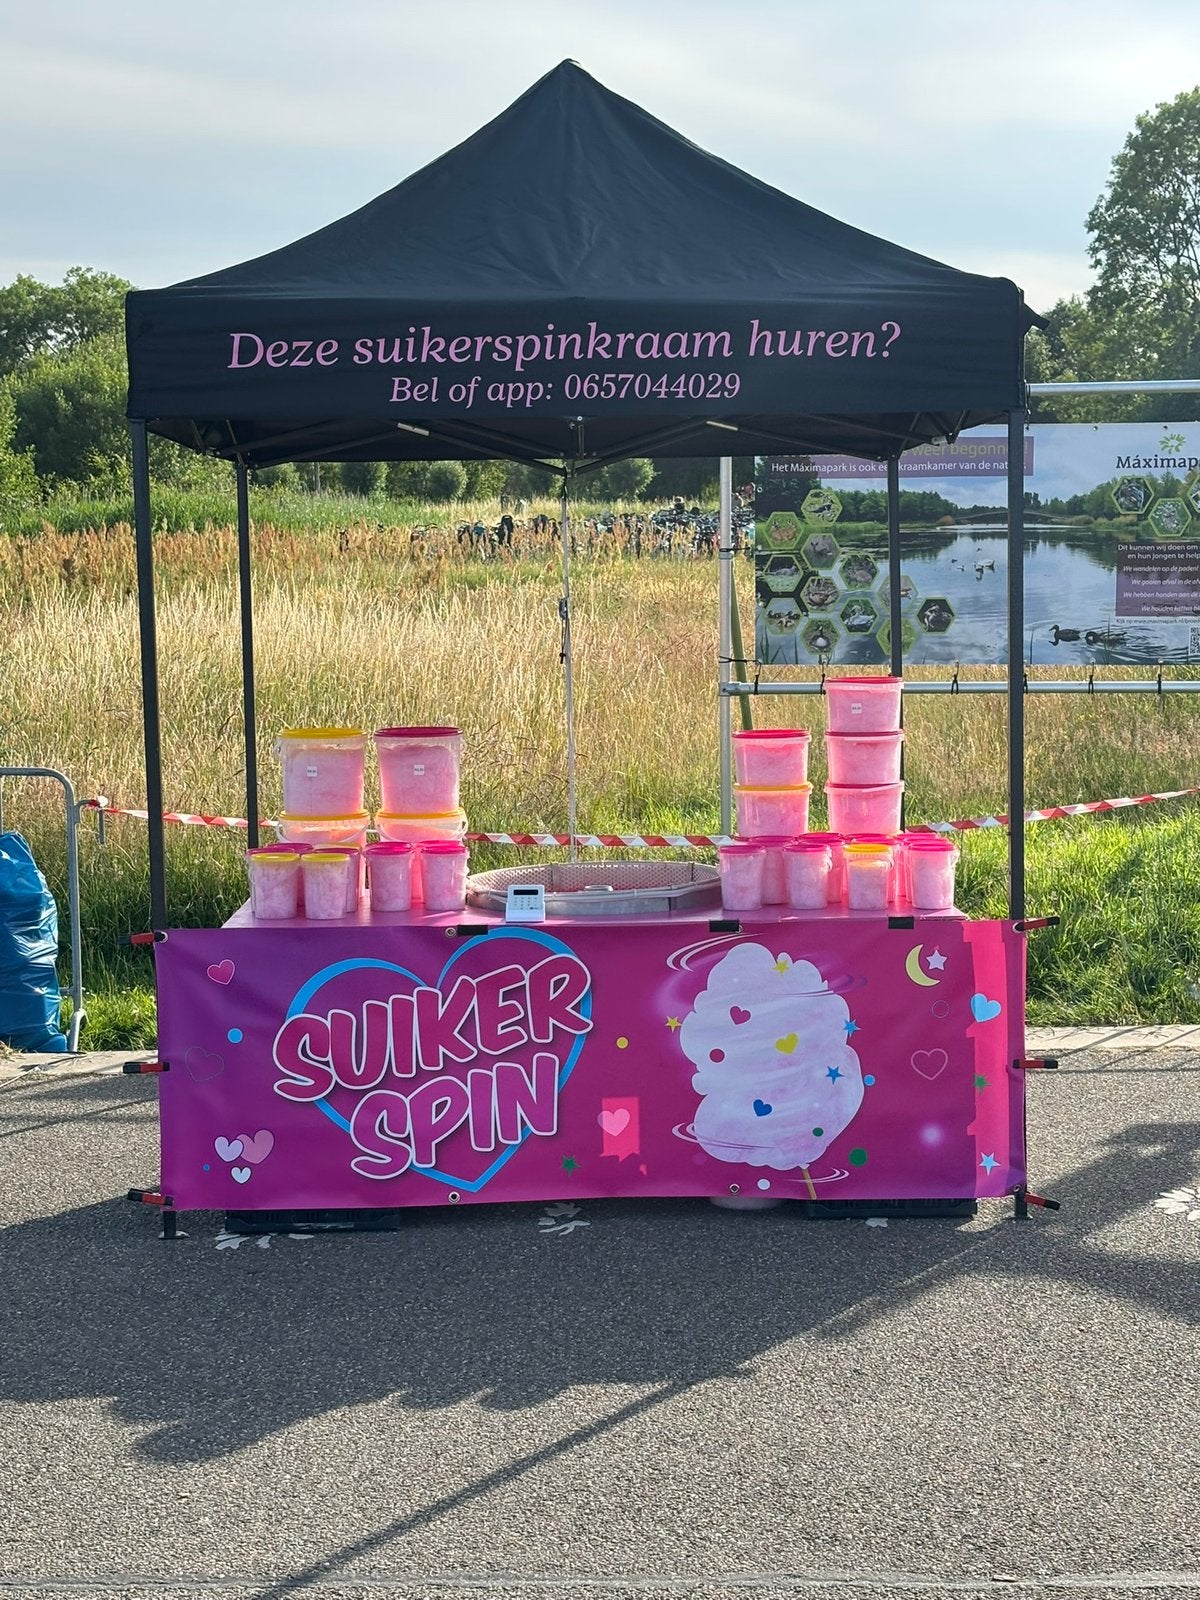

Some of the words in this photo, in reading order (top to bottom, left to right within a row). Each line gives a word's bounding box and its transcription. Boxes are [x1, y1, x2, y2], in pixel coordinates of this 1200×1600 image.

[227, 332, 339, 369] Deze
[352, 321, 735, 372] suikerspinkraam
[748, 318, 901, 358] huren?
[389, 376, 440, 402] Bel
[448, 375, 481, 409] of
[486, 380, 553, 408] app:
[563, 373, 741, 400] 0657044029
[771, 463, 788, 472] Het
[790, 462, 848, 475] Máximapark
[849, 463, 856, 472] is
[858, 462, 876, 472] ook
[898, 461, 957, 471] kraamkamer
[958, 461, 976, 470] van
[978, 460, 991, 470] de
[1116, 454, 1200, 471] Máximap
[1152, 553, 1177, 561] jongen
[273, 953, 594, 1103] SUIKER
[350, 1052, 560, 1180] SPIN
